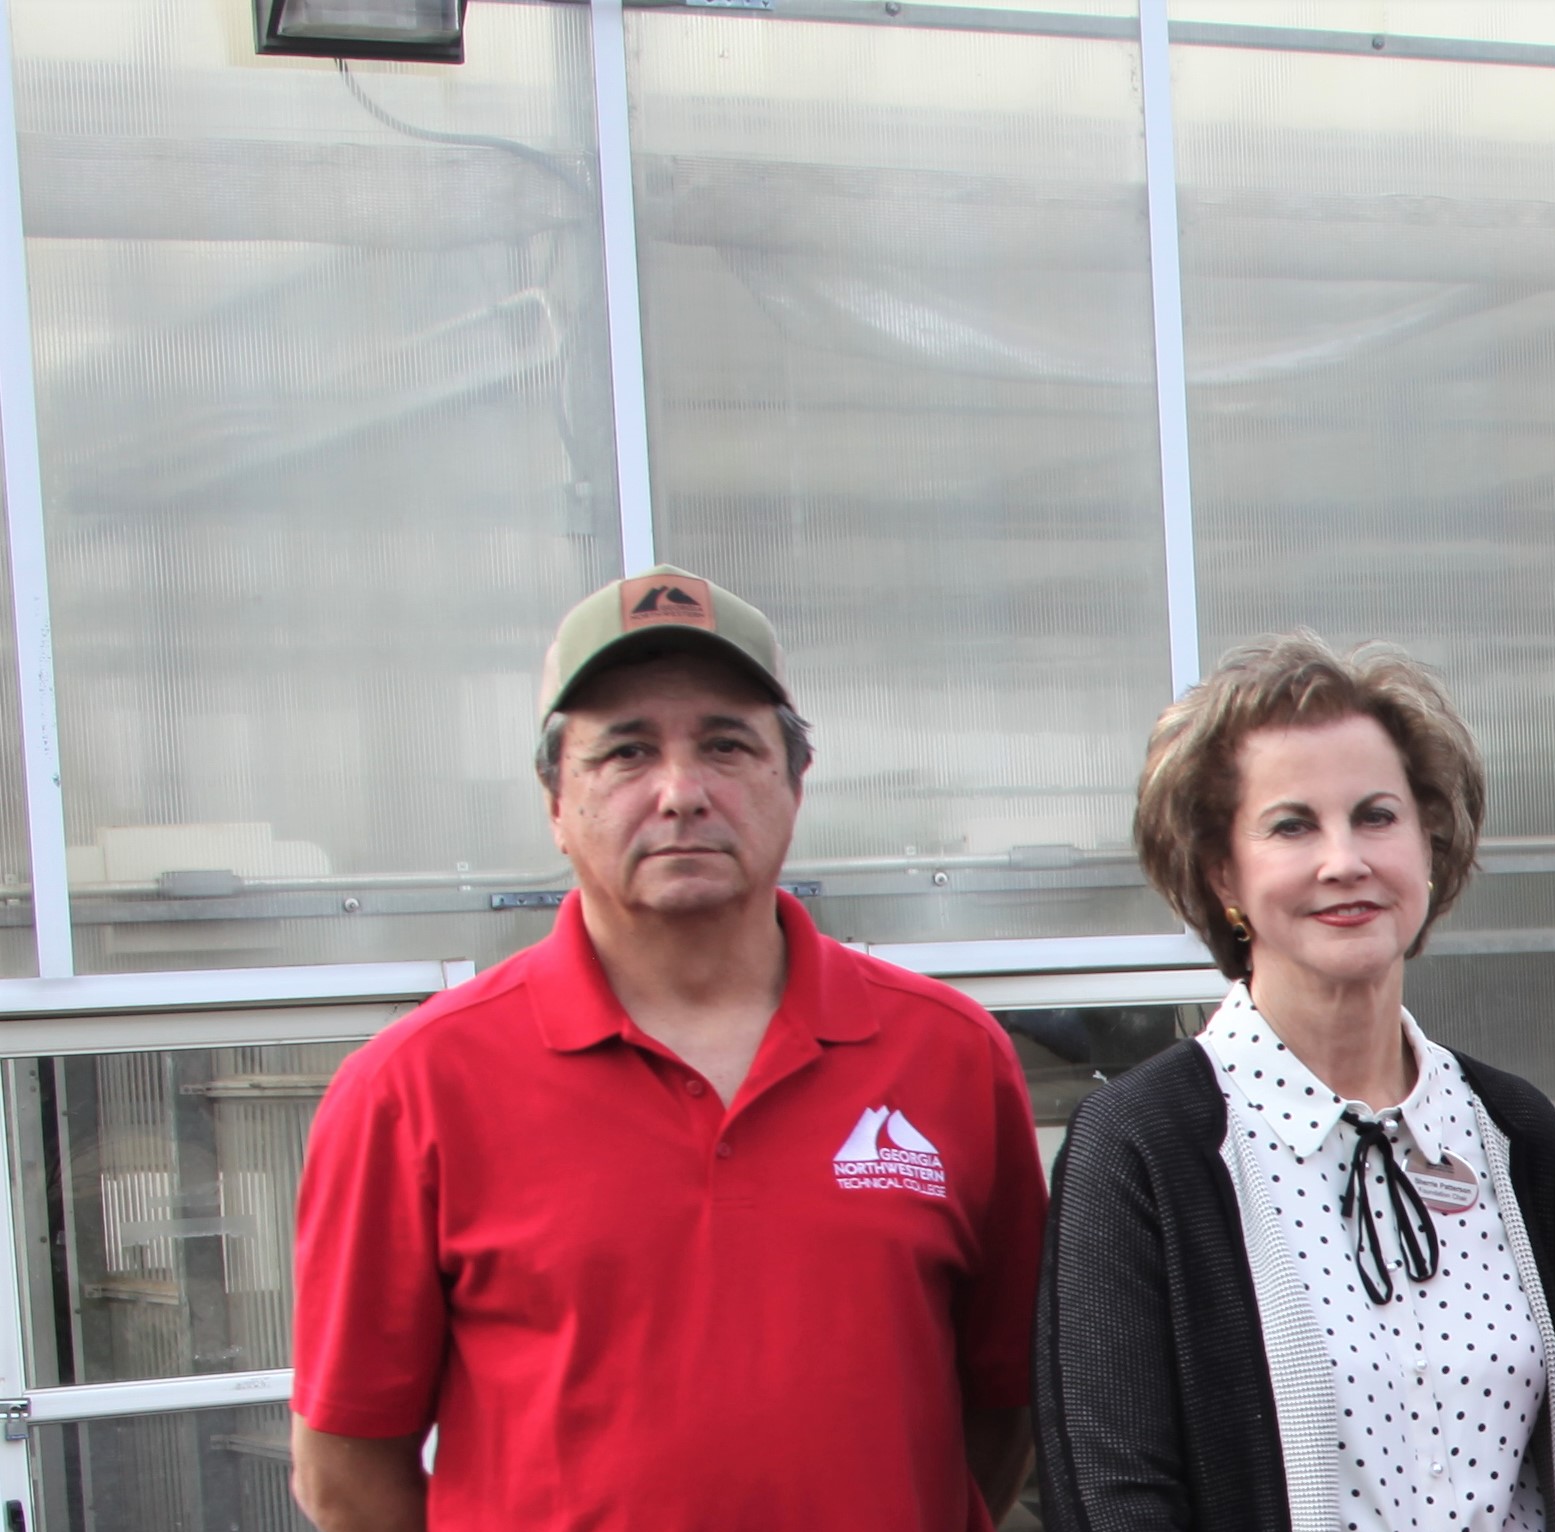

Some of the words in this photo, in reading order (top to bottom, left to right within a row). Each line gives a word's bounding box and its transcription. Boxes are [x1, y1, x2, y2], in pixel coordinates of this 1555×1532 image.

[879, 1148, 942, 1167] GEORGIA
[833, 1162, 945, 1182] NORTHWESTERN
[836, 1178, 903, 1189] TECHNICAL
[904, 1180, 947, 1198] COLLEGE
